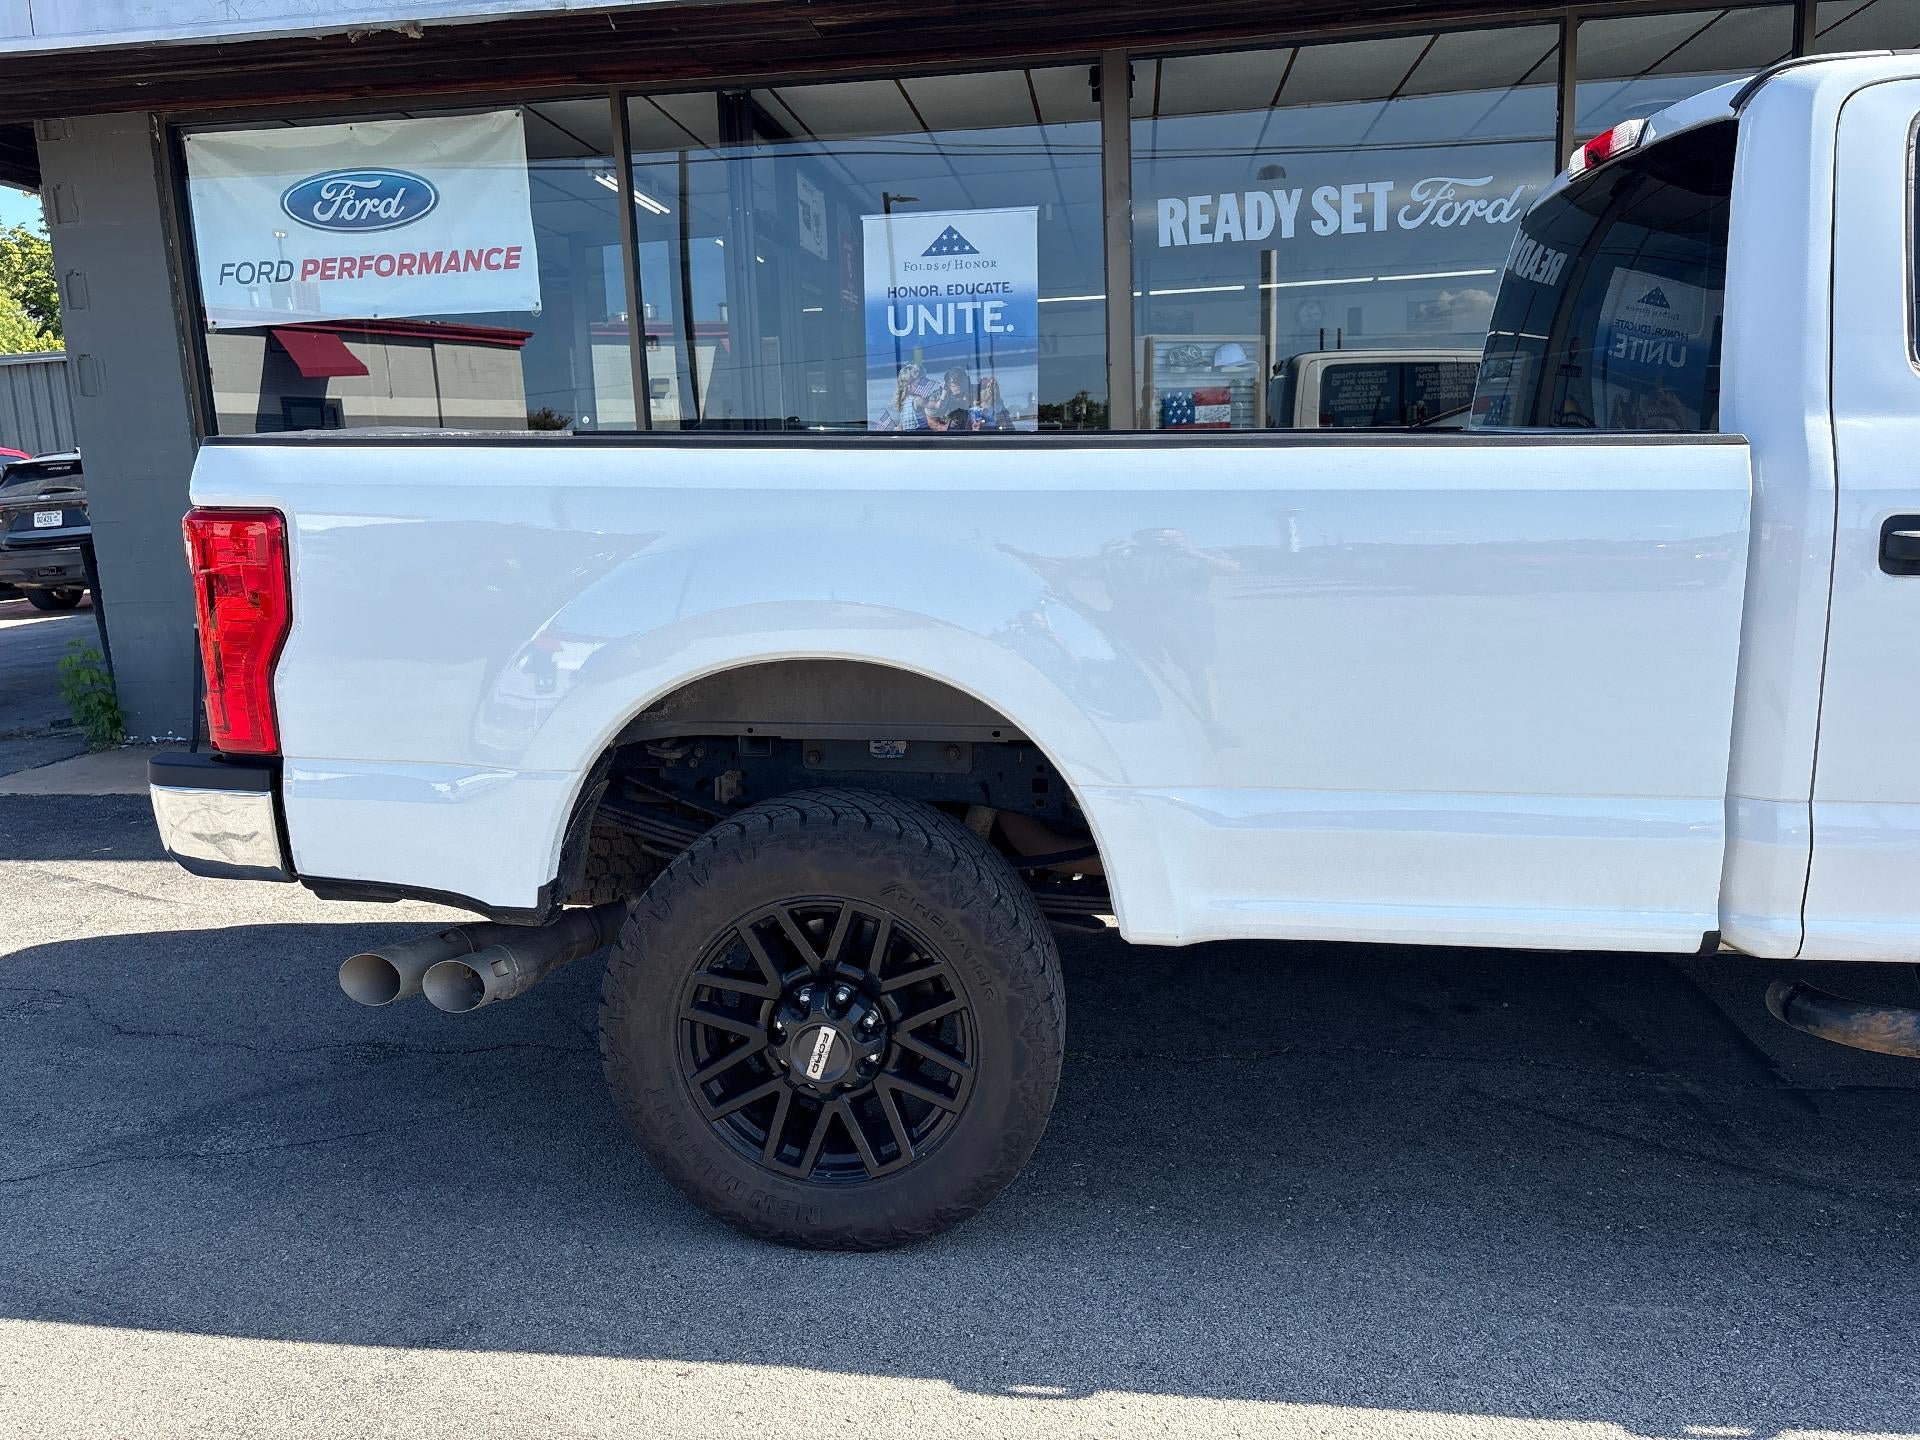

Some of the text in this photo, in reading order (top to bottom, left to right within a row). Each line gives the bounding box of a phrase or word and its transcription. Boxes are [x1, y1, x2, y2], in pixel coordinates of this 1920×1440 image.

[314, 178, 405, 224] Ford
[1157, 188, 1303, 248] READY
[1310, 180, 1394, 238] SET
[1397, 175, 1525, 230] Ford
[219, 246, 522, 286] FORD PERFORMANCE
[887, 281, 1013, 298] HONOR. EDUCATE.
[887, 301, 1015, 337] UNITE.
[811, 1032, 829, 1074] FORD
